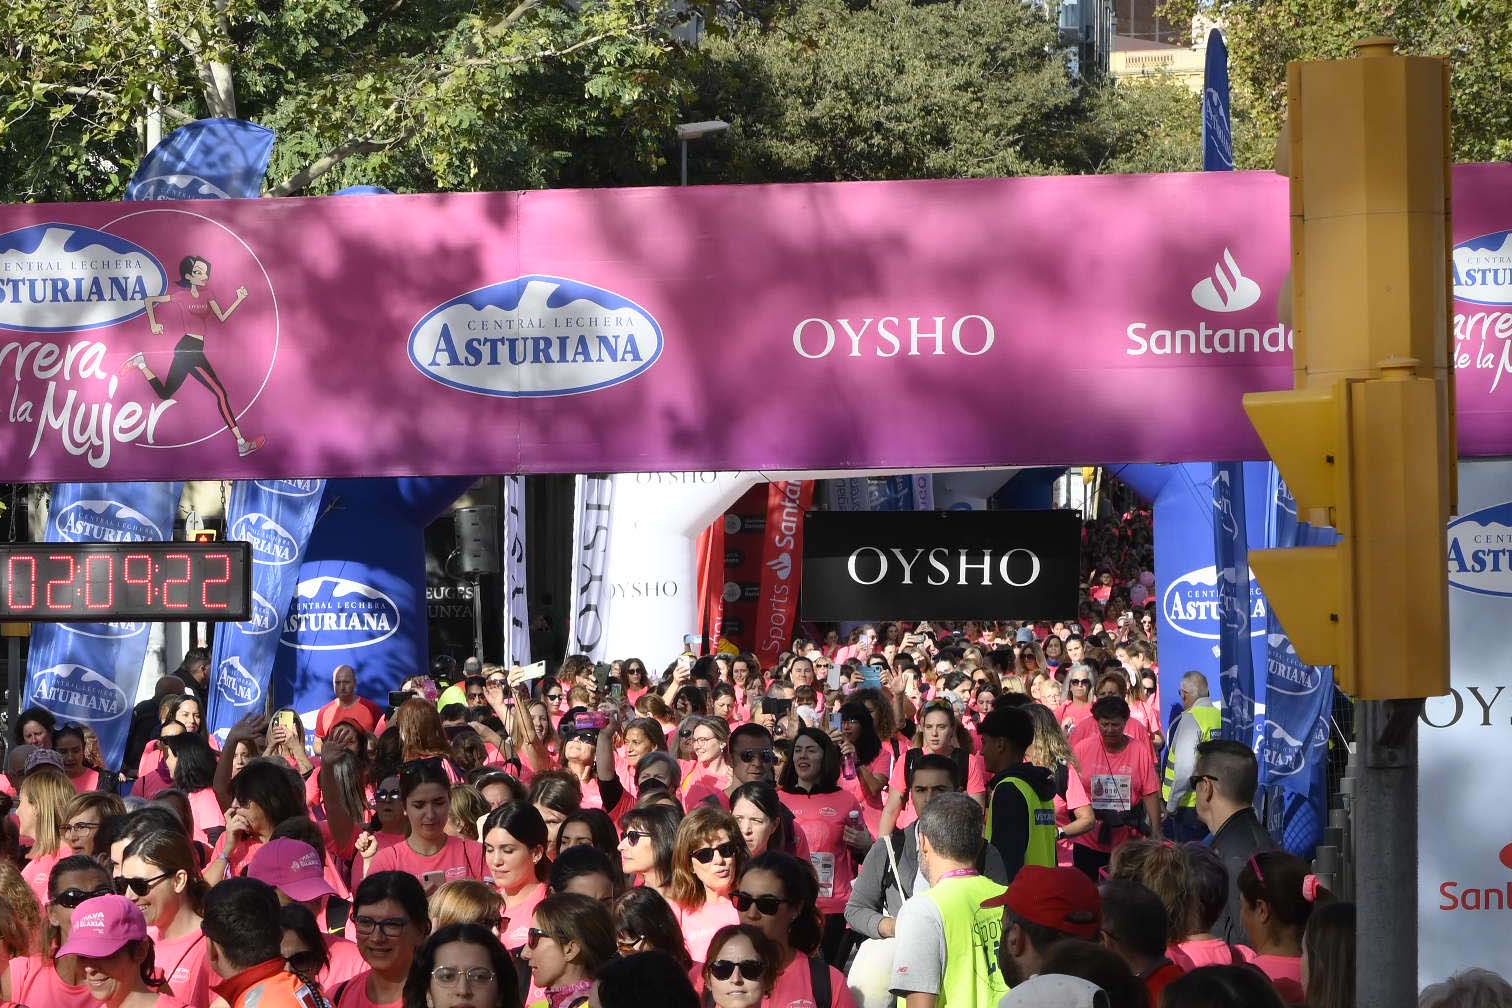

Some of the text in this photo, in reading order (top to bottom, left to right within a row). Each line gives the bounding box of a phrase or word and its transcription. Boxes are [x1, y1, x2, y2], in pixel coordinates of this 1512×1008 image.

[71, 258, 143, 271] LECHERA
[429, 323, 644, 367] ASTURIANA
[467, 317, 635, 330] CENTRAL LECHERA
[792, 314, 995, 359] OYSHO
[1126, 321, 1294, 356] Santand
[8, 383, 33, 424] la
[29, 371, 178, 469] Mujer
[8, 553, 231, 609] 02:09:22
[846, 545, 1041, 588] OYSHO
[429, 604, 474, 619] UNYA
[763, 583, 791, 653] Sports
[34, 678, 118, 714] ASTURIANA
[1419, 685, 1512, 728] OY
